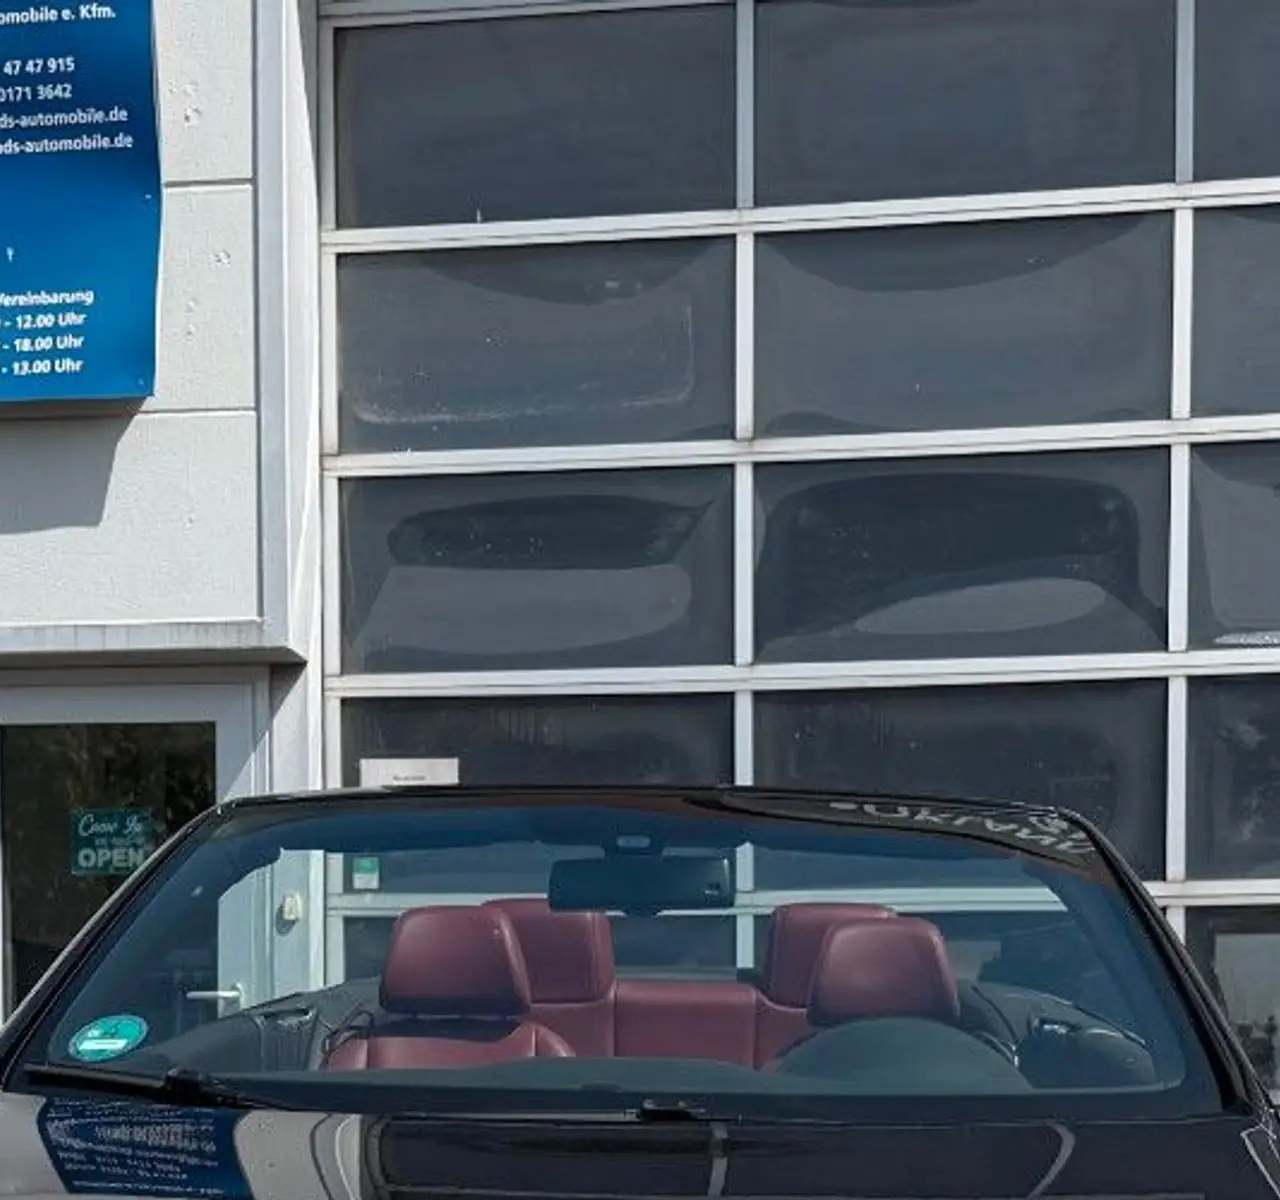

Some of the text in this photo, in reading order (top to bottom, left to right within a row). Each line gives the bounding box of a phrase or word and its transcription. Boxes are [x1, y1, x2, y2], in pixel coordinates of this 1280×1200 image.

[61, 9, 75, 21] e.
[79, 3, 116, 20] Kfm.
[4, 60, 22, 76] 47
[25, 59, 43, 74] 47
[47, 56, 75, 73] 915
[37, 84, 72, 99] 3642
[16, 314, 55, 329] 12.00
[58, 312, 87, 326] Uhr
[56, 334, 84, 349] Uhr
[55, 358, 84, 373] Uhr
[78, 847, 144, 868] OPEN
